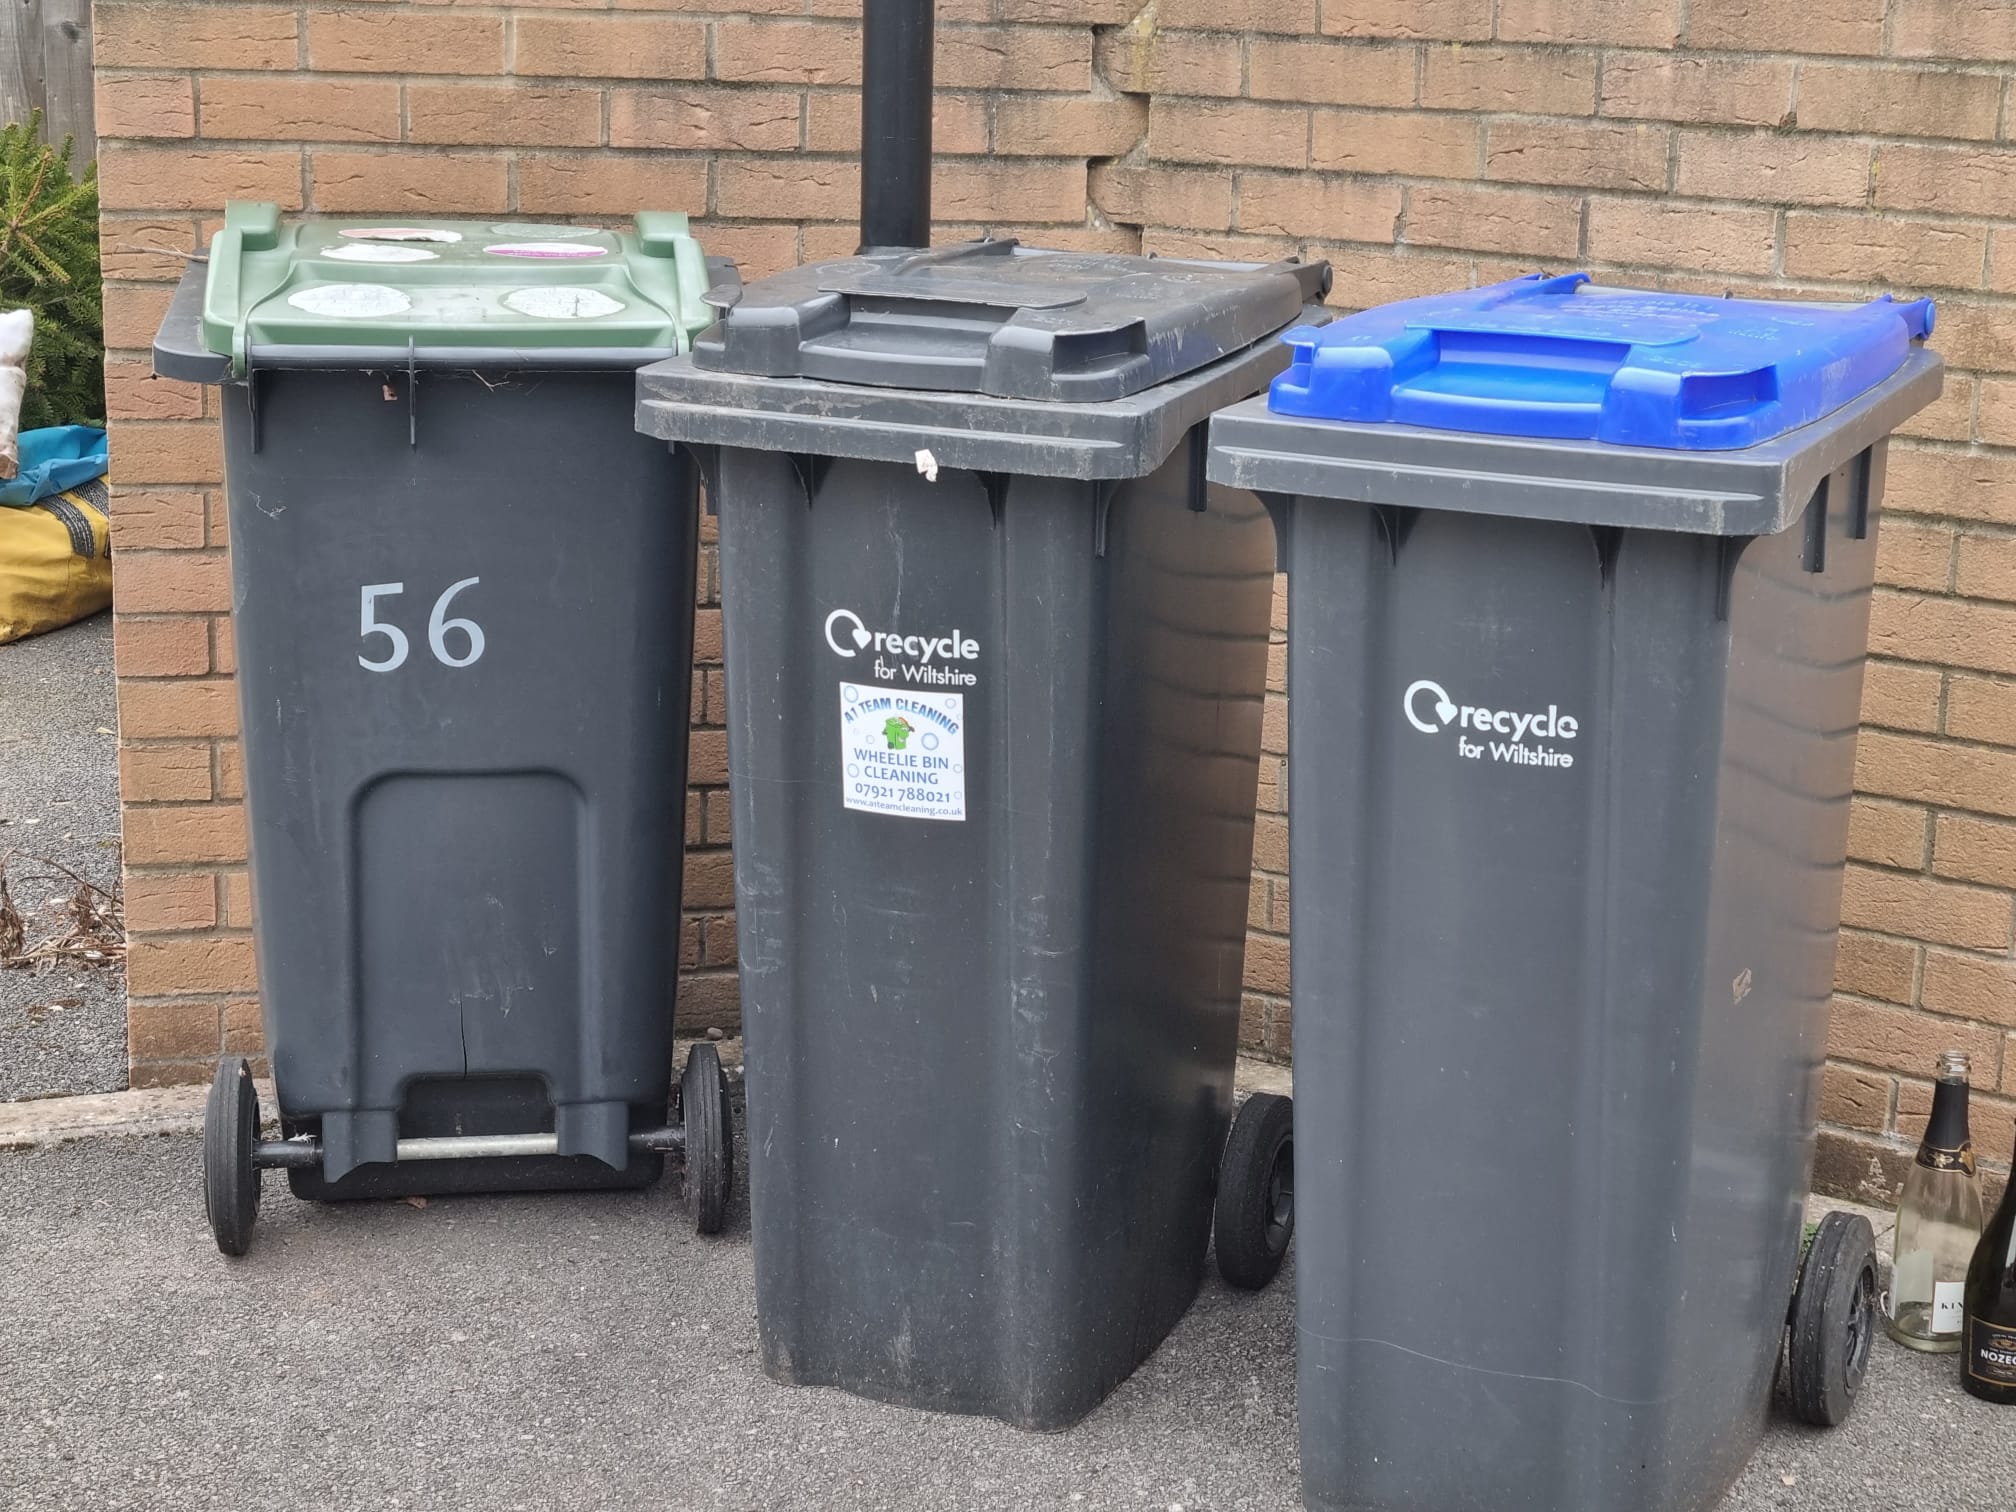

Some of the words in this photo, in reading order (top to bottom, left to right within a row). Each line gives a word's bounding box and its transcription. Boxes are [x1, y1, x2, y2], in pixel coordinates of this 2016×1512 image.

[358, 576, 485, 672] 56
[874, 629, 980, 663] recycle
[874, 657, 896, 680] for
[901, 664, 977, 686] Wiltshire
[844, 707, 858, 724] A1
[858, 697, 891, 714] TEAM
[895, 697, 959, 735] CLEANING
[1460, 704, 1579, 742] recycle
[854, 748, 918, 767] WHEELIE
[922, 756, 949, 769] BIN
[1458, 735, 1484, 759] for
[1489, 741, 1574, 768] Wiltshire
[864, 765, 939, 785] CLEANING
[846, 797, 962, 816] www.a1teamcleaning.co.uk
[855, 782, 894, 799] 07921
[898, 787, 950, 803] 788021
